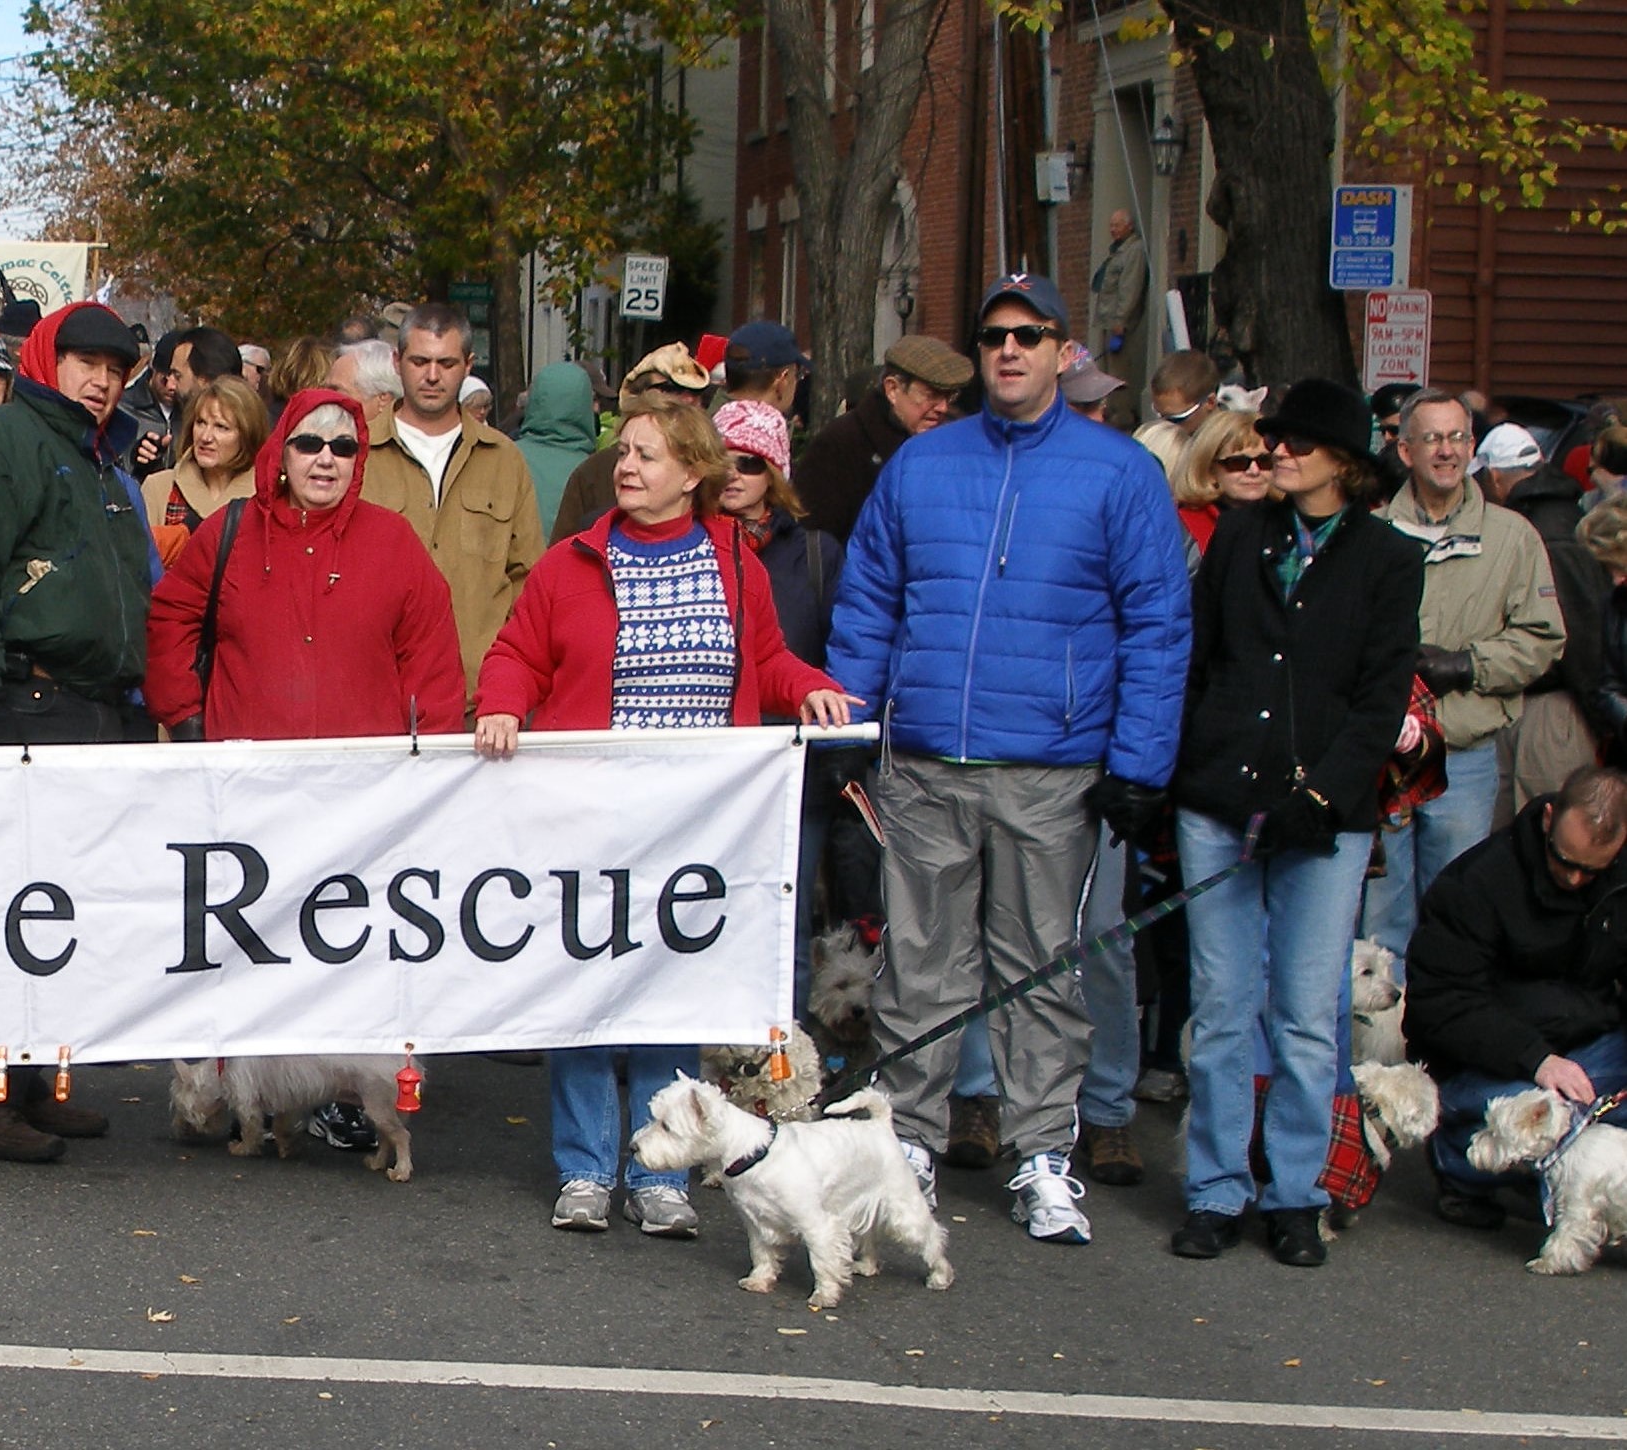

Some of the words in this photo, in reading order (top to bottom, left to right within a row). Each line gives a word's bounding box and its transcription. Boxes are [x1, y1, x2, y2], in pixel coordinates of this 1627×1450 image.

[1341, 191, 1393, 206] DASH
[628, 261, 663, 272] SPEED
[630, 275, 658, 285] LIMIT
[626, 288, 660, 311] 25
[1369, 298, 1387, 317] NO
[1388, 301, 1426, 314] PARKING
[1371, 344, 1422, 356] LOADING
[1380, 359, 1410, 370] ZONE
[165, 842, 727, 974] Rescue
